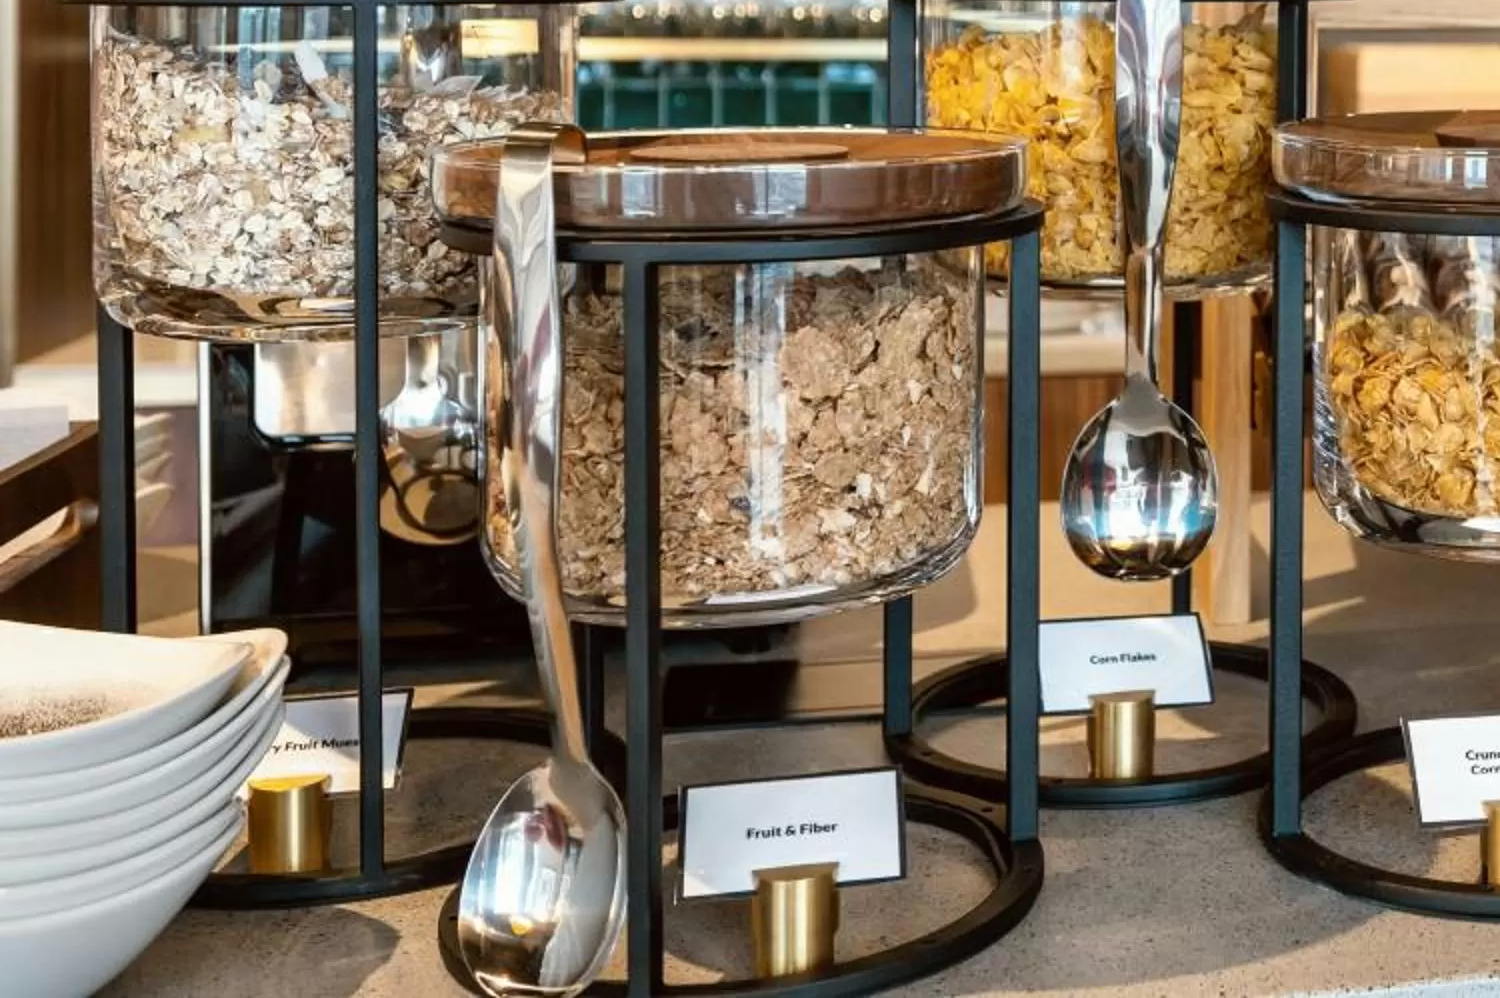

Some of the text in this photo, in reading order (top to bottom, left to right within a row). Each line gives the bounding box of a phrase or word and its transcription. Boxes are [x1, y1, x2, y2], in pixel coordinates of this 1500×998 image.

[1089, 651, 1157, 666] Corn Flakes
[284, 739, 318, 751] Fruit
[321, 737, 359, 750] Mues
[746, 822, 839, 840] Fruit & Fiber
